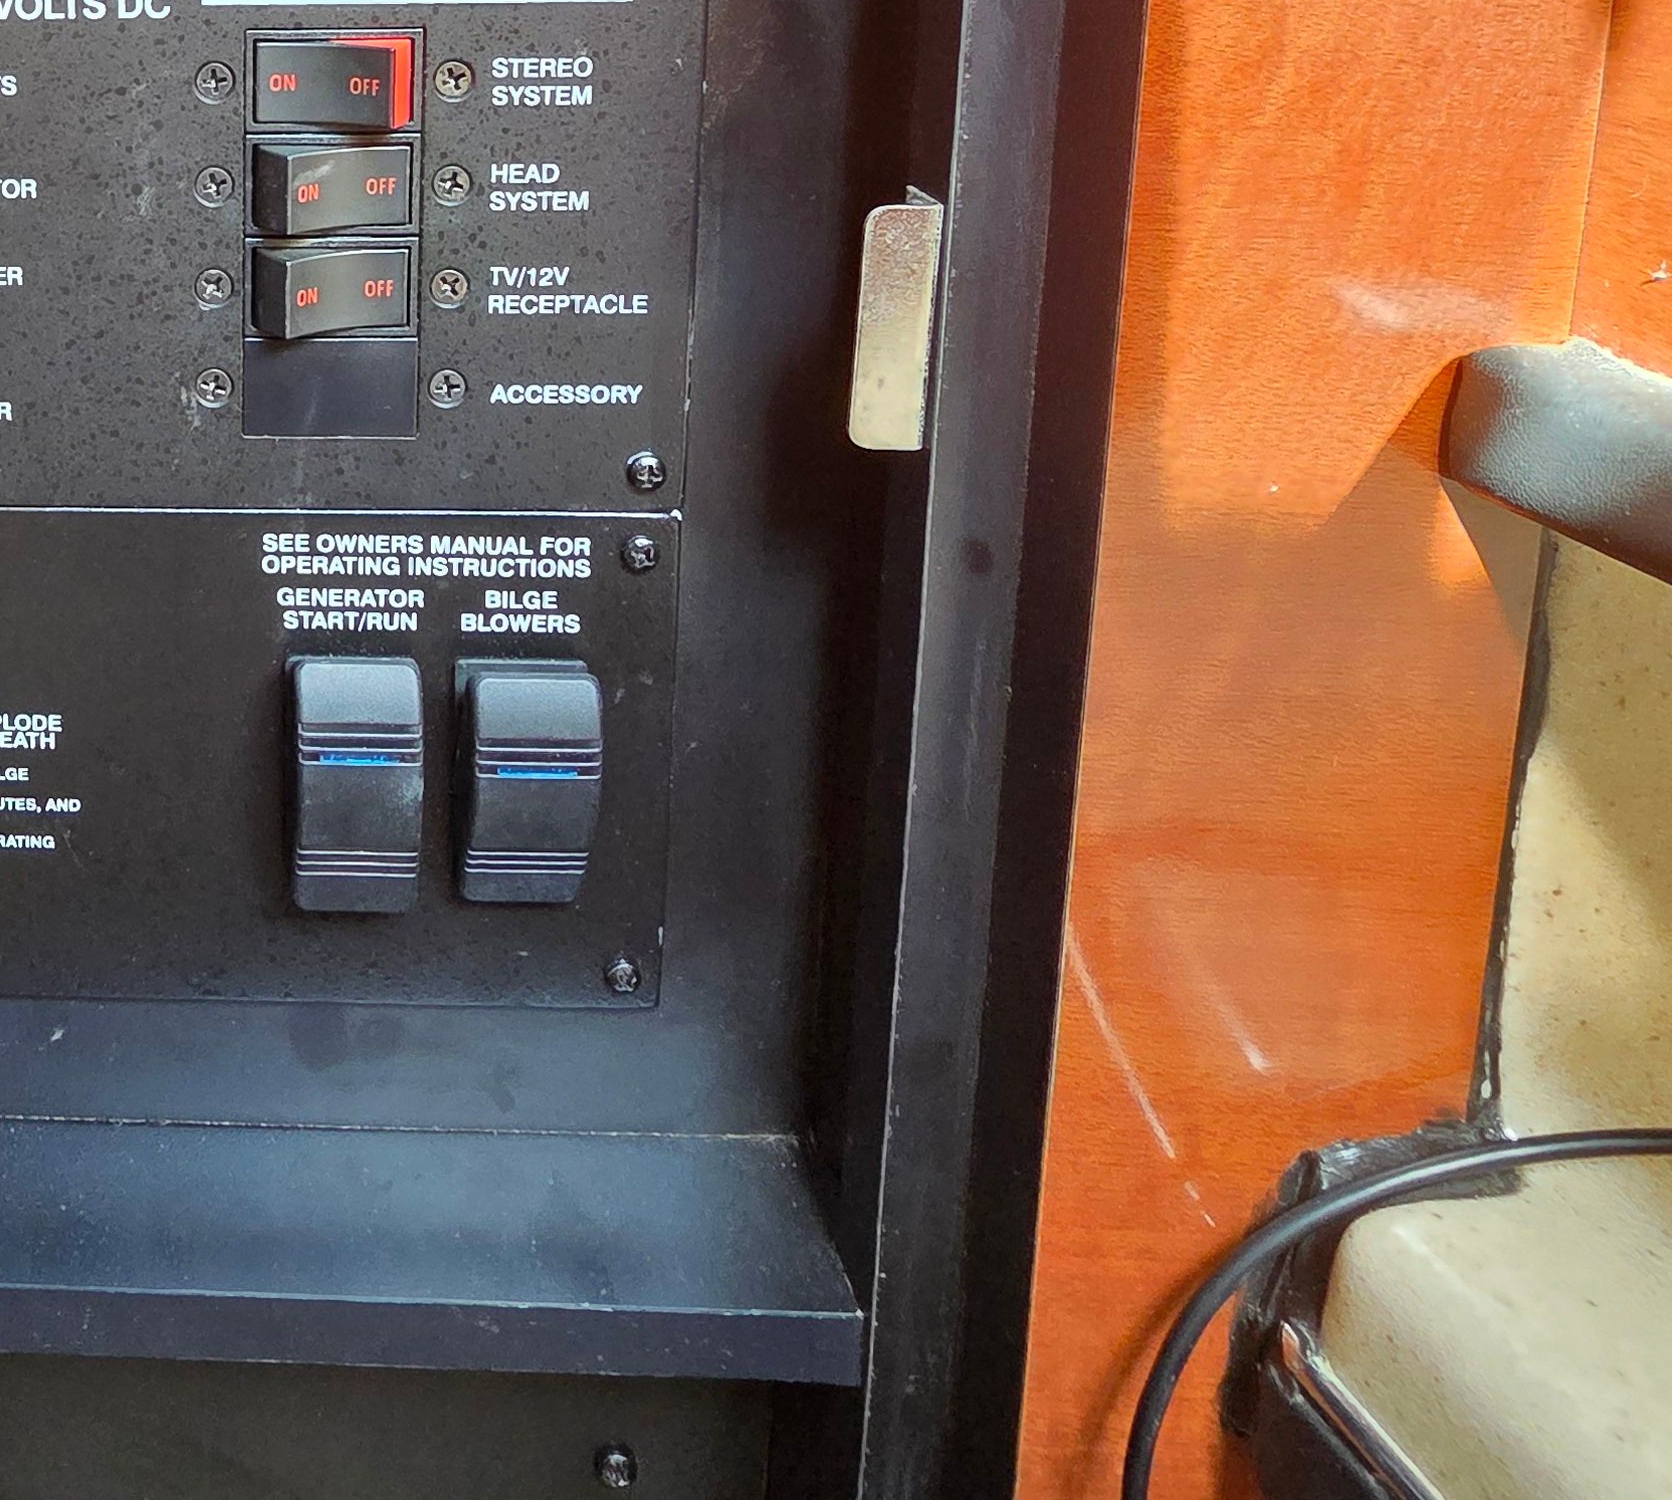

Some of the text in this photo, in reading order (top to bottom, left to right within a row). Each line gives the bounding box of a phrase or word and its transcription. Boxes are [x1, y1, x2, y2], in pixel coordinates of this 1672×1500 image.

[492, 57, 593, 78] STEREO
[270, 75, 296, 91] ON
[350, 78, 379, 95] OFF
[492, 85, 592, 106] SYSTEM
[491, 164, 559, 183] HEAD
[298, 184, 319, 202] ON
[366, 178, 396, 194] OFF
[490, 191, 589, 211] SYSTEM
[490, 267, 569, 288] TV/12V
[297, 288, 317, 306] ON
[365, 280, 393, 297] OFF
[488, 294, 648, 314] RECEPTACLE
[490, 384, 642, 404] ACCESSORY
[263, 534, 591, 556] SEE OWNERS MANUAL FOR
[262, 555, 591, 578] OPERATING INSTRUCTIONS
[277, 587, 424, 608] GENERATOR
[485, 590, 557, 610] BILGE
[283, 610, 417, 631] START/RUN
[461, 613, 580, 633] BLOWERS
[46, 798, 81, 812] AND
